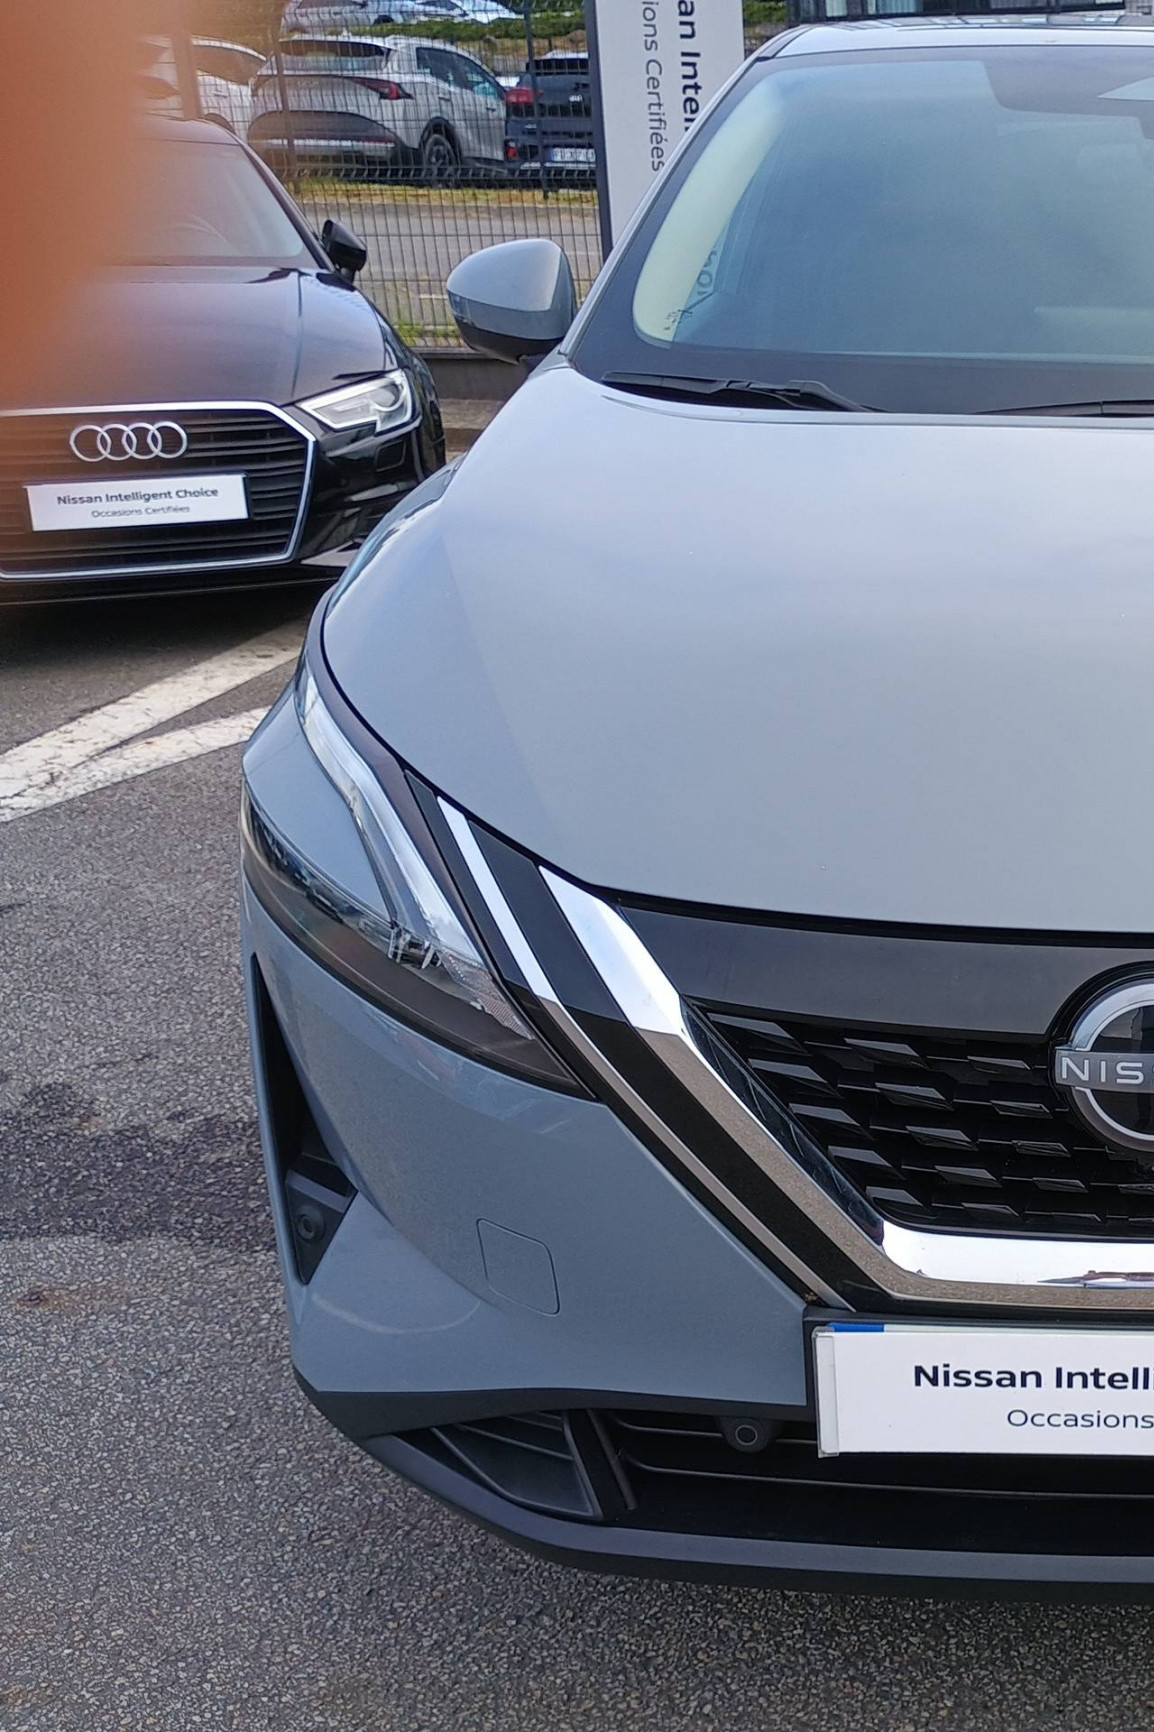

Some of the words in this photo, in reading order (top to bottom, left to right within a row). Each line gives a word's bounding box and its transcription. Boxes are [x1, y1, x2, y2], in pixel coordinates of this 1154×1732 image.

[646, 59, 669, 172] Certifiées
[56, 494, 102, 505] Nissan
[105, 490, 173, 503] Intelligent
[175, 487, 219, 499] Choice
[91, 507, 142, 518] Occasions
[914, 1363, 1042, 1388] Nissan
[1007, 1409, 1154, 1429] Occasions
